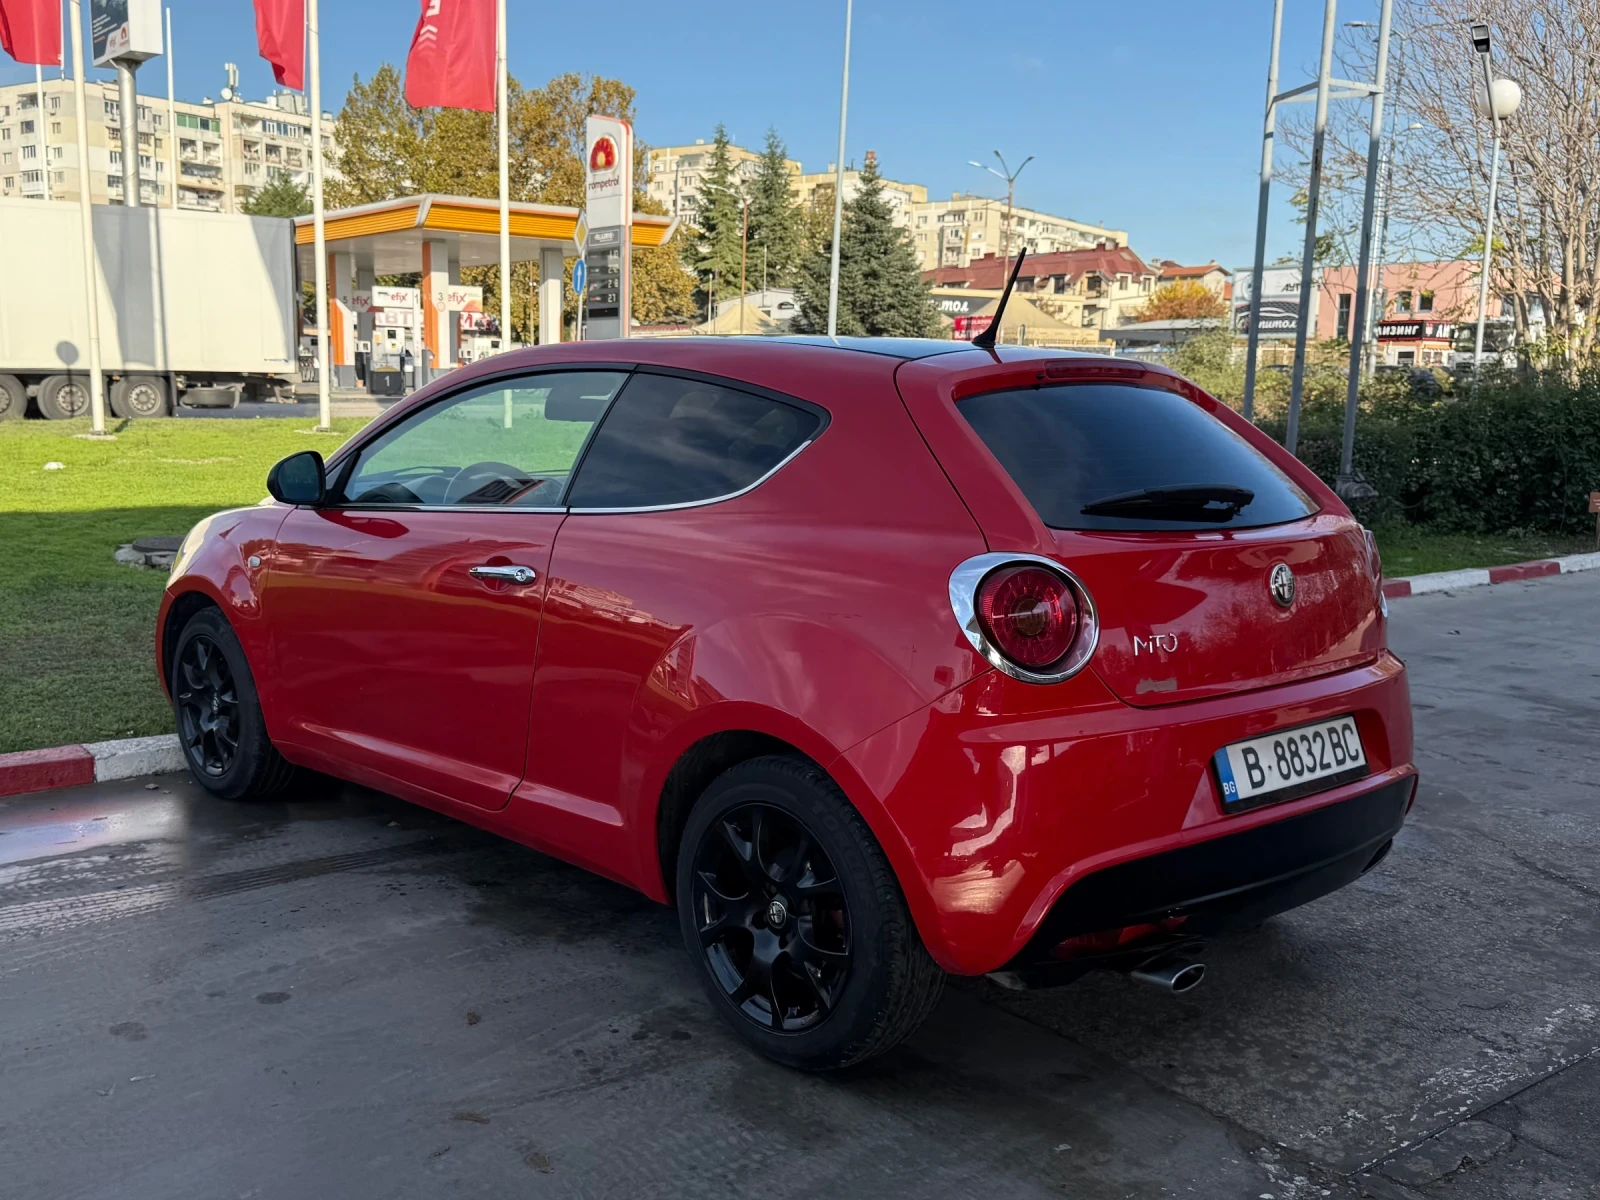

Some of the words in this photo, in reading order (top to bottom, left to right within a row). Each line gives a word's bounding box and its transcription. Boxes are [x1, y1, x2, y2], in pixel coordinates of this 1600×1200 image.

[588, 178, 620, 192] rompetrol
[343, 295, 348, 304] 5
[352, 296, 370, 307] efix
[391, 292, 408, 304] efix
[437, 292, 444, 302] 3
[448, 292, 467, 305] efix
[384, 376, 391, 387] 1
[1223, 781, 1236, 795] BG
